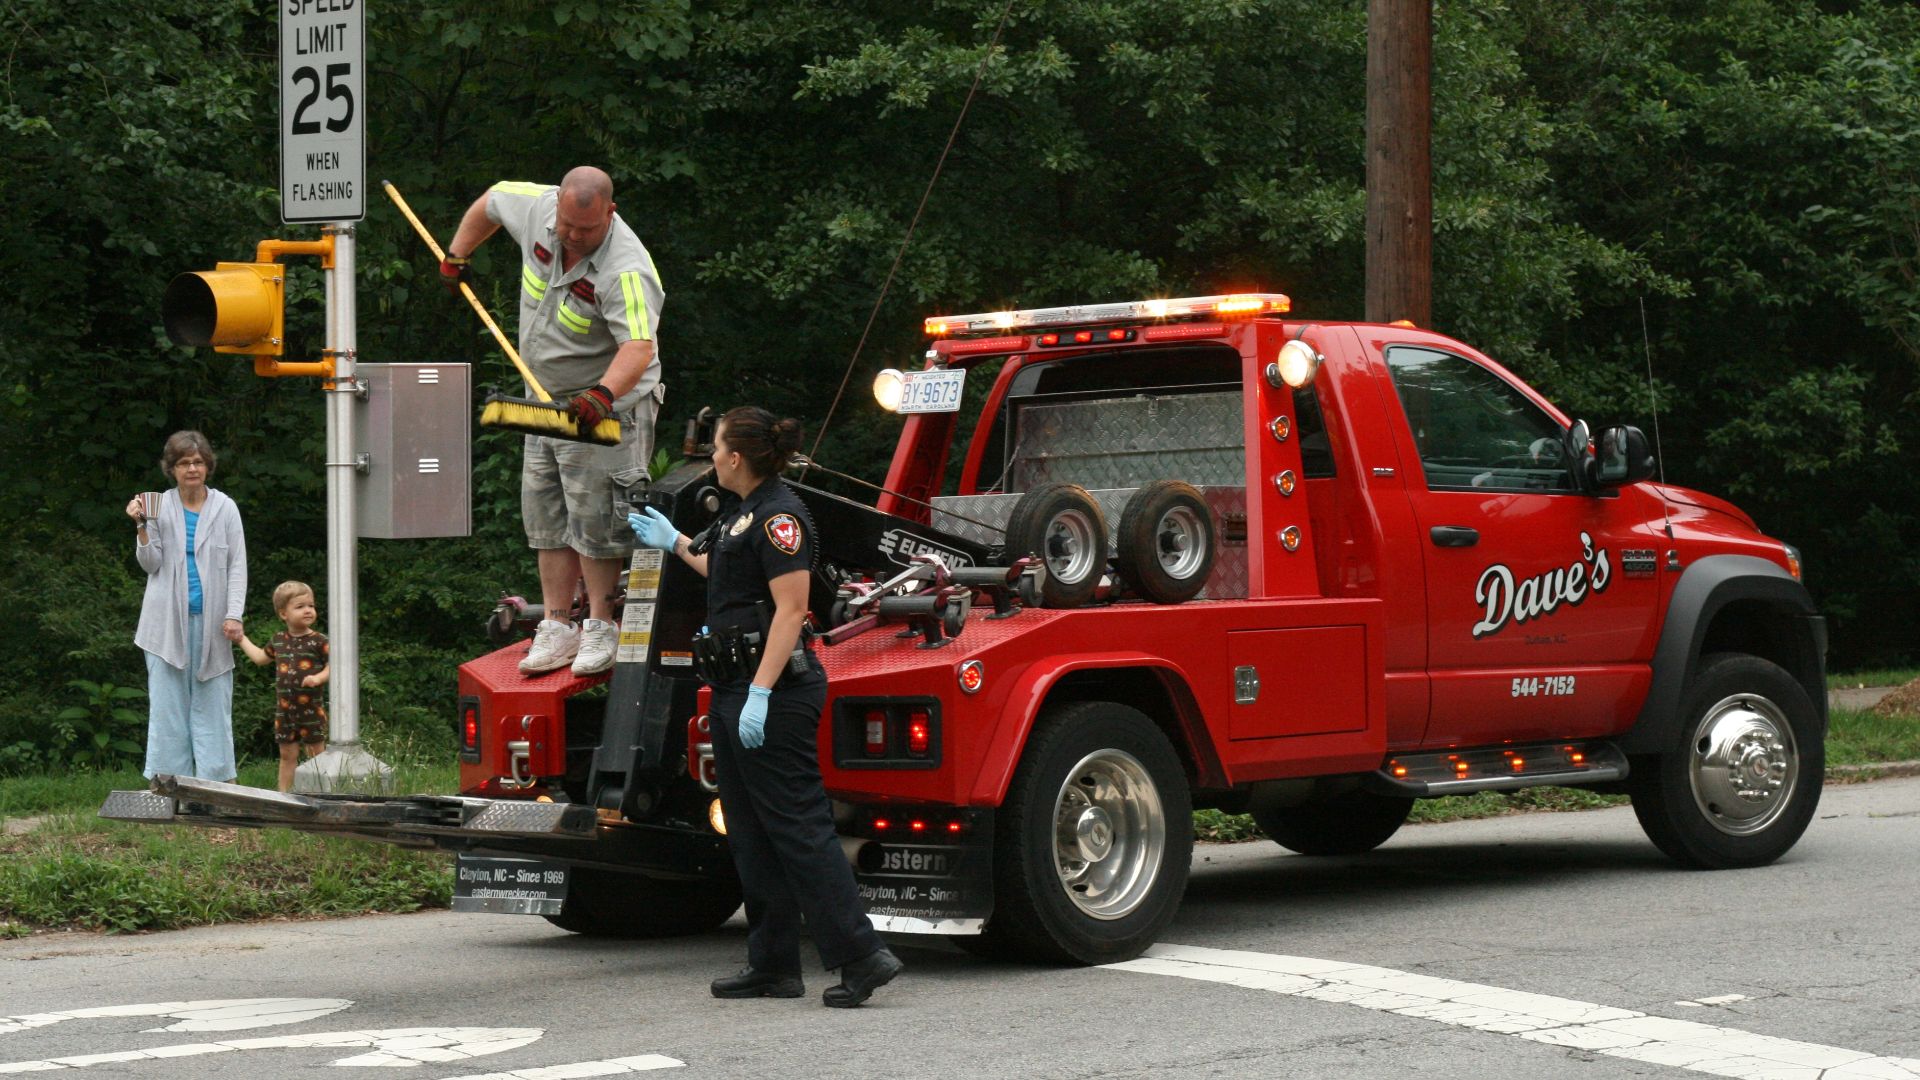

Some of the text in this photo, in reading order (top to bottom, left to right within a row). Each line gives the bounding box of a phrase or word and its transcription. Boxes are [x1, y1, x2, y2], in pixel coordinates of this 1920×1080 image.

[296, 23, 347, 55] LIMIT
[291, 63, 354, 135] 25
[306, 152, 339, 171] WHEN
[293, 181, 353, 201] FLASHING
[901, 381, 959, 404] BY-9673
[1472, 531, 1611, 638] Dave's
[1511, 675, 1576, 698] 544-7152
[880, 848, 947, 871] astern
[460, 867, 492, 884] Clayton,
[494, 868, 507, 882] NC
[517, 869, 540, 883] Since
[543, 870, 564, 884] 1969
[900, 886, 917, 900] NC
[929, 887, 959, 901] Since
